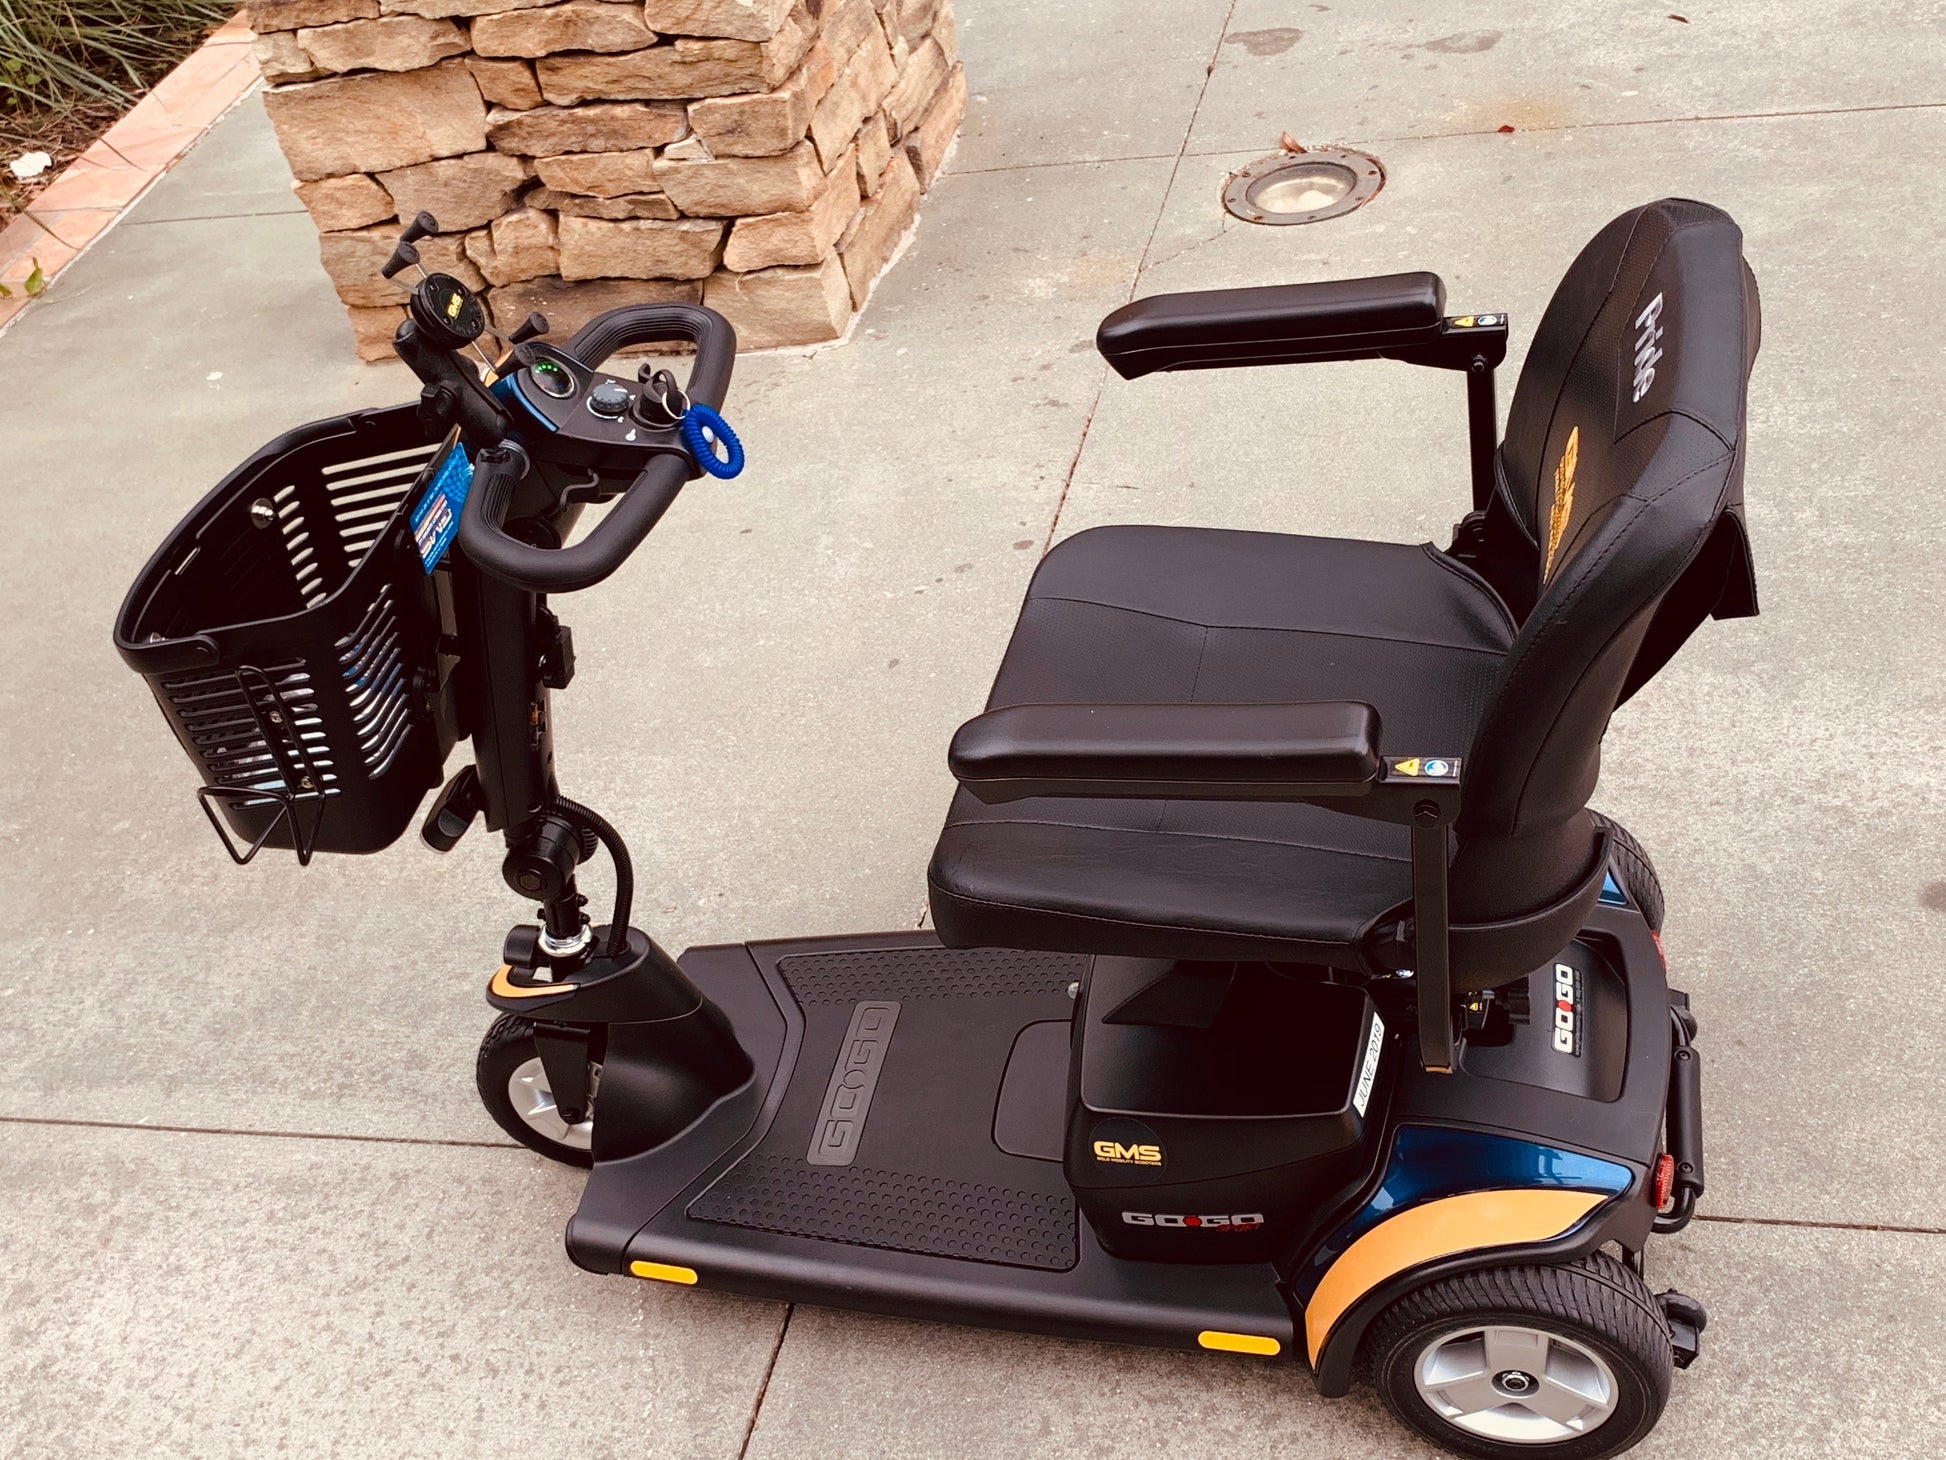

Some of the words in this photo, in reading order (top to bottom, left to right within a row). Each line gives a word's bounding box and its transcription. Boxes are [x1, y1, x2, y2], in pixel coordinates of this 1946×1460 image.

[447, 293, 461, 317] GMS
[1632, 292, 1663, 403] Pride
[1358, 1060, 1374, 1107] JUNE
[1369, 1023, 1382, 1062] 2019
[1094, 1141, 1161, 1161] GMS
